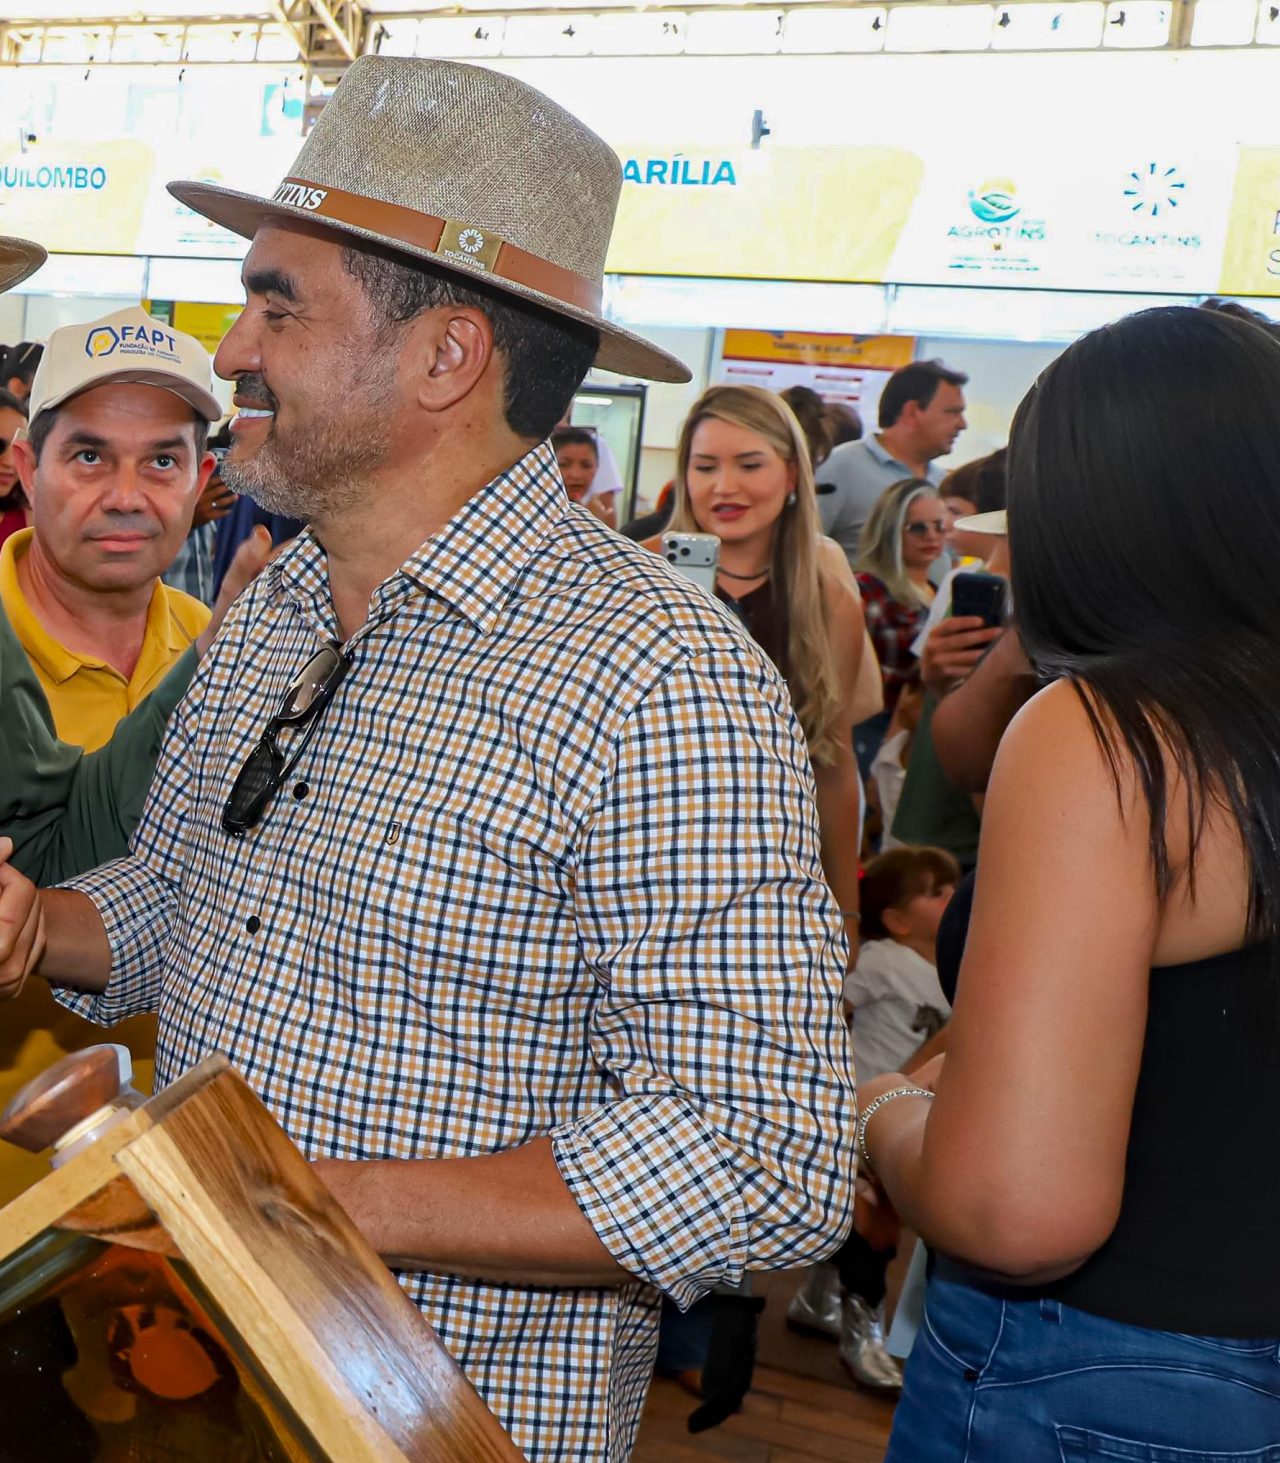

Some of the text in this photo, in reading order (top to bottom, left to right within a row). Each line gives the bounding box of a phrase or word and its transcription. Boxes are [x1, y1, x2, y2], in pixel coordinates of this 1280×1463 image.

[623, 153, 737, 186] ARÍLIA
[444, 249, 486, 270] TOCANTINS
[121, 325, 176, 352] FAPT
